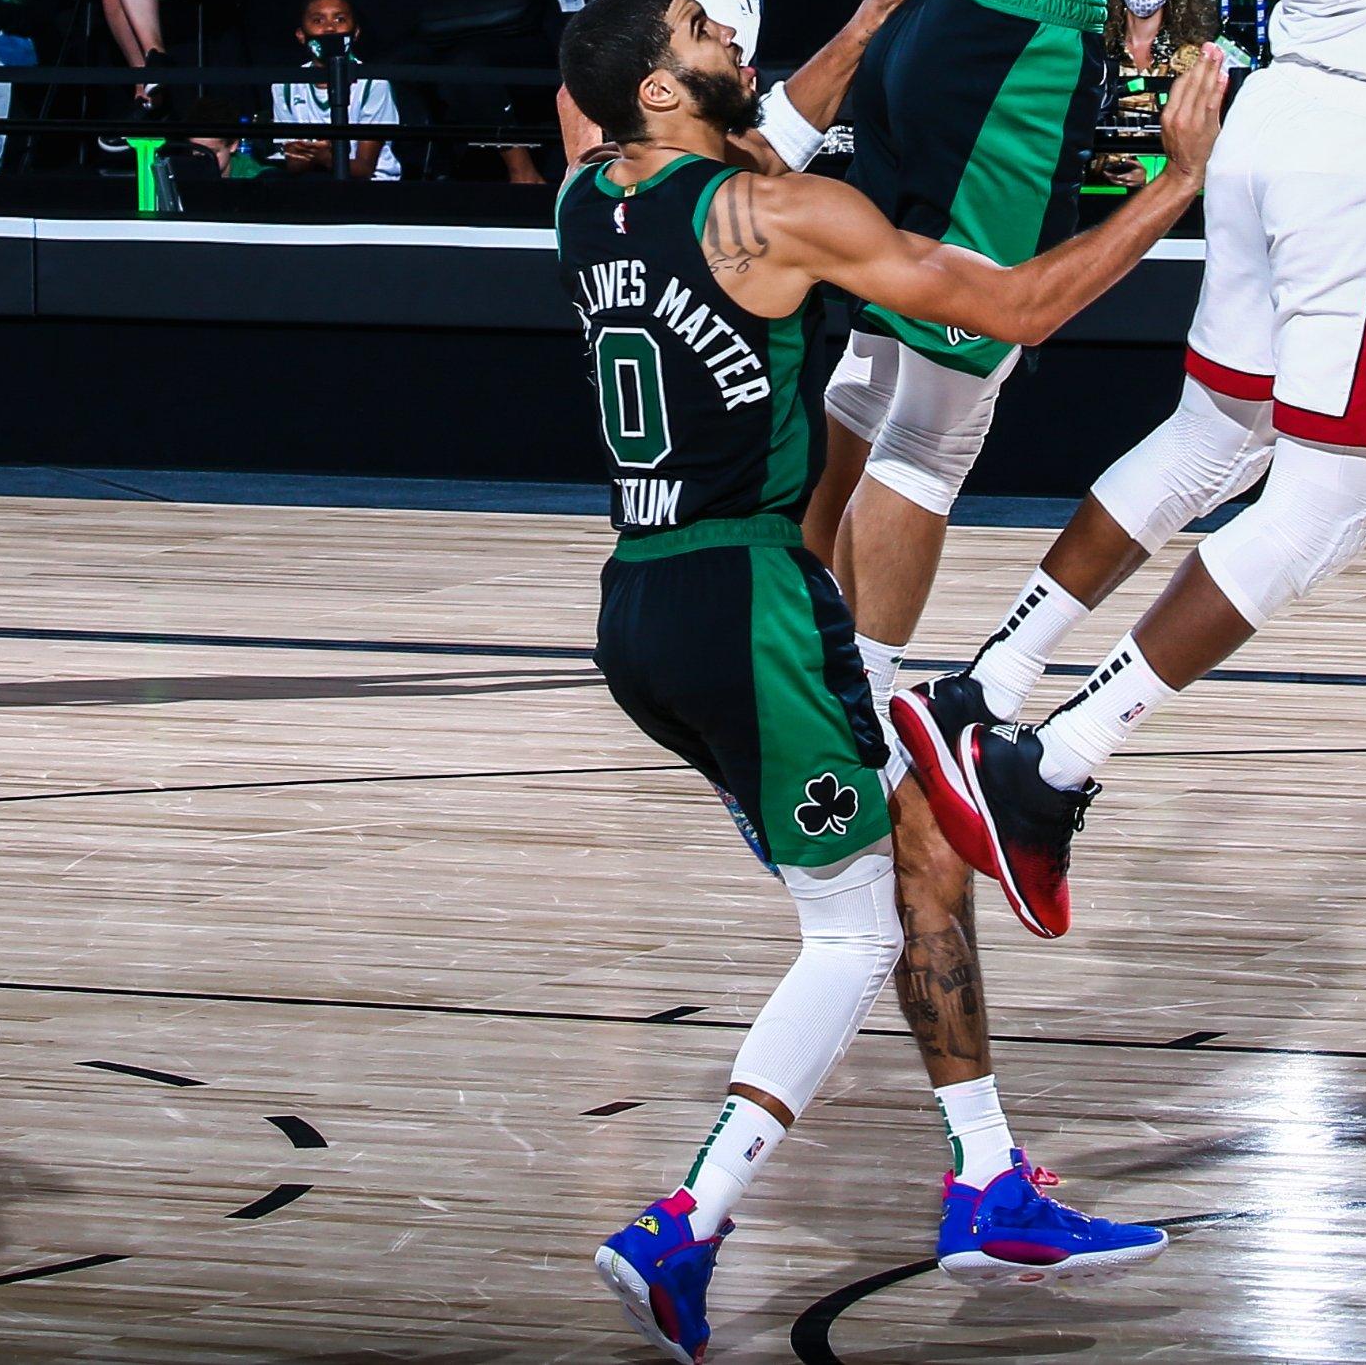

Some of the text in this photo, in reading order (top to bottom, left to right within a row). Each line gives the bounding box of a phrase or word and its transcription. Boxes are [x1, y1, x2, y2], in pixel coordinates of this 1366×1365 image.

[578, 259, 647, 315] LIVES
[653, 276, 771, 411] MATTER
[595, 326, 672, 469] 0
